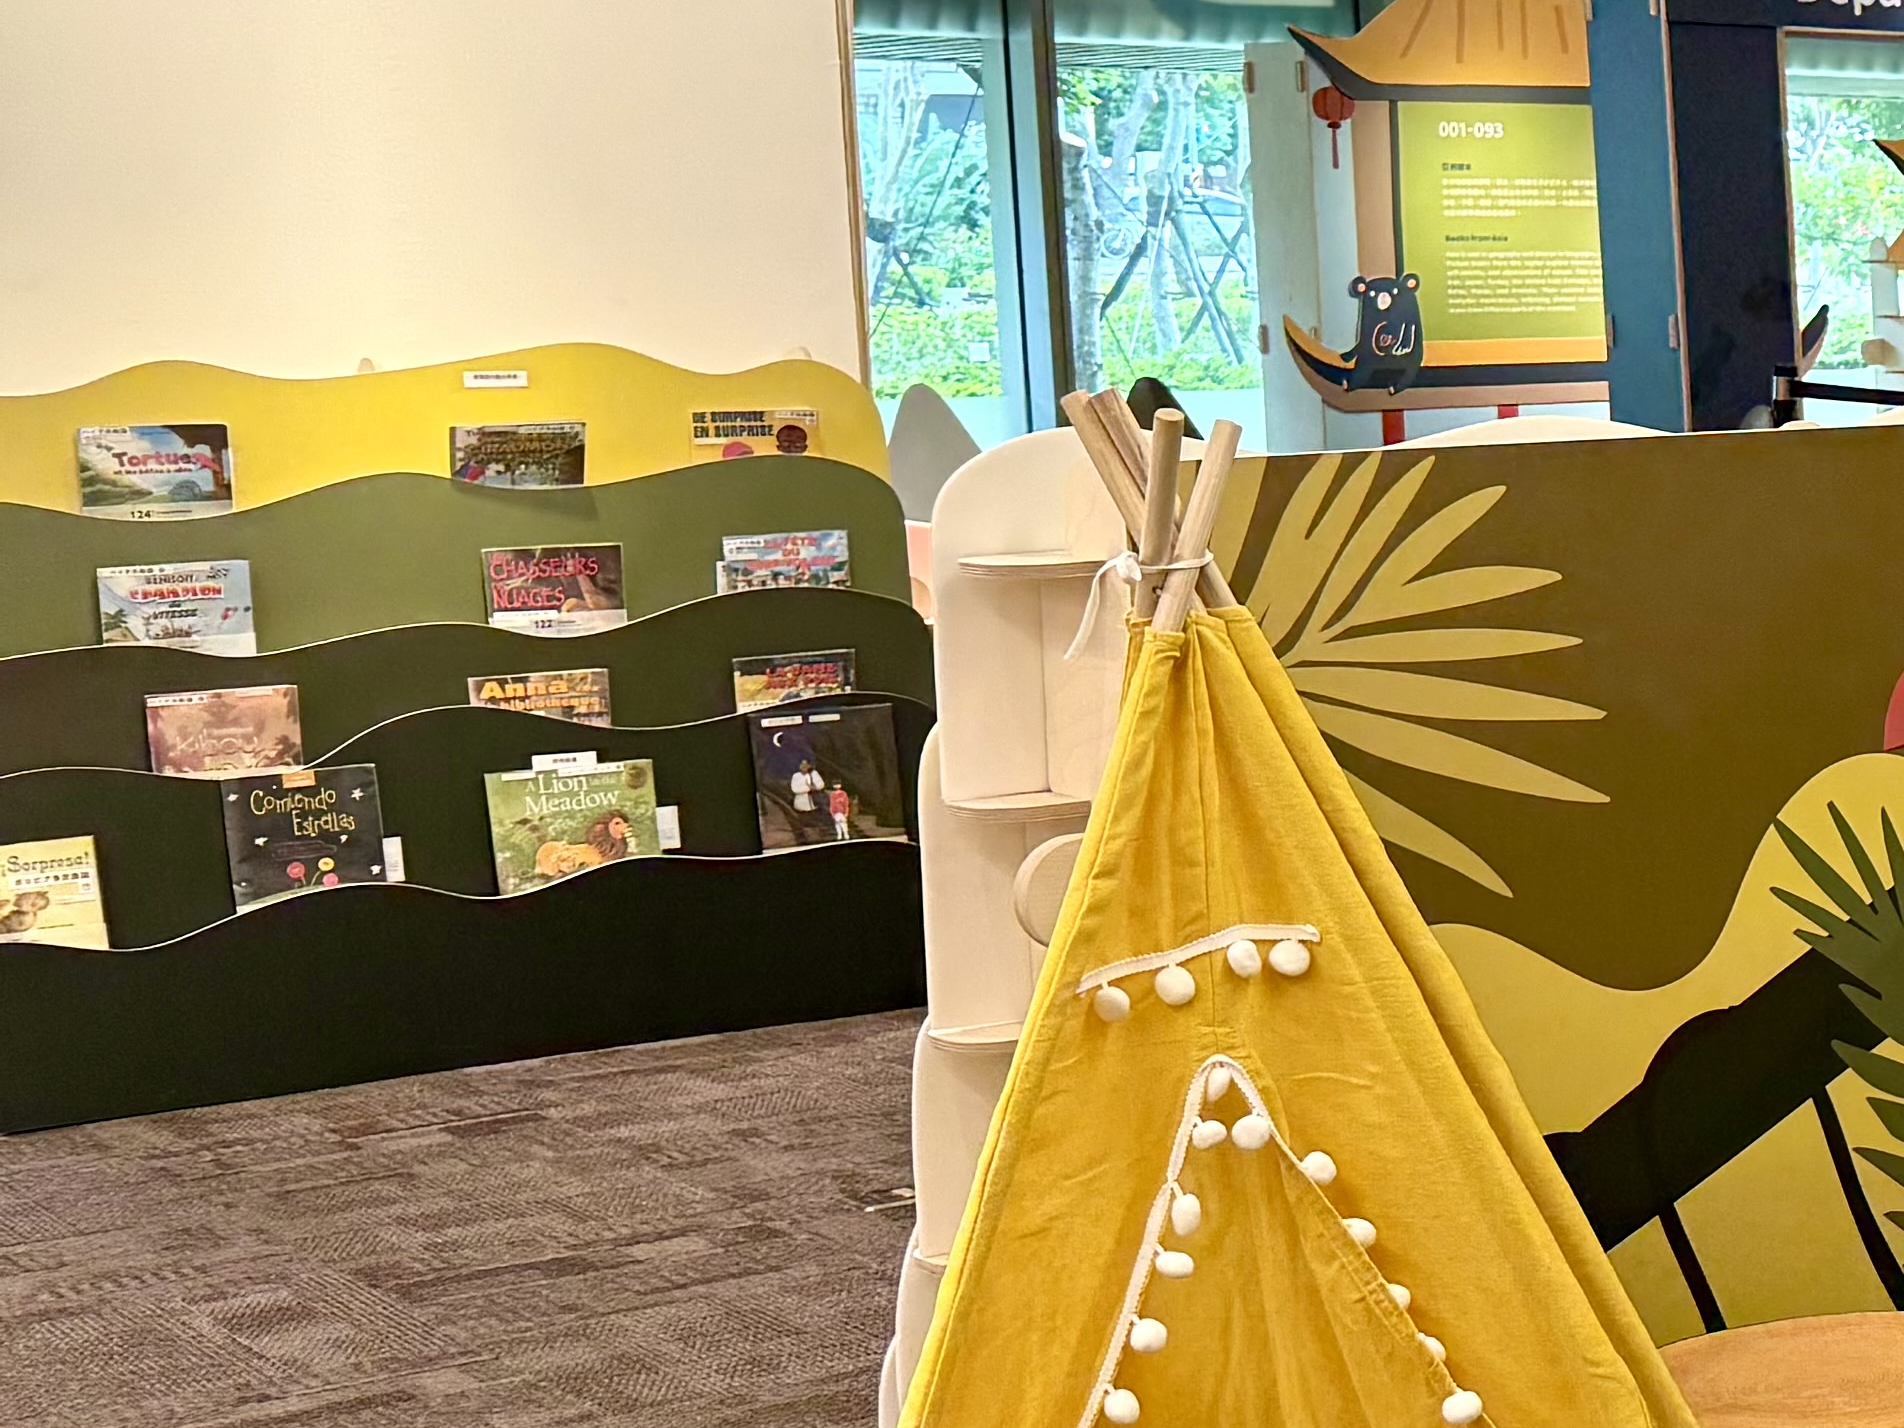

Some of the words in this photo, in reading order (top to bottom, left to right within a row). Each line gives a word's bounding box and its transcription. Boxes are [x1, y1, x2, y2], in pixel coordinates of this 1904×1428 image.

[489, 557, 599, 581] CHASSEURS
[491, 582, 565, 609] NUAGES
[480, 680, 569, 700] Anna
[538, 774, 589, 794] Lion
[250, 788, 337, 815] Comiendo
[525, 790, 621, 815] Meadow
